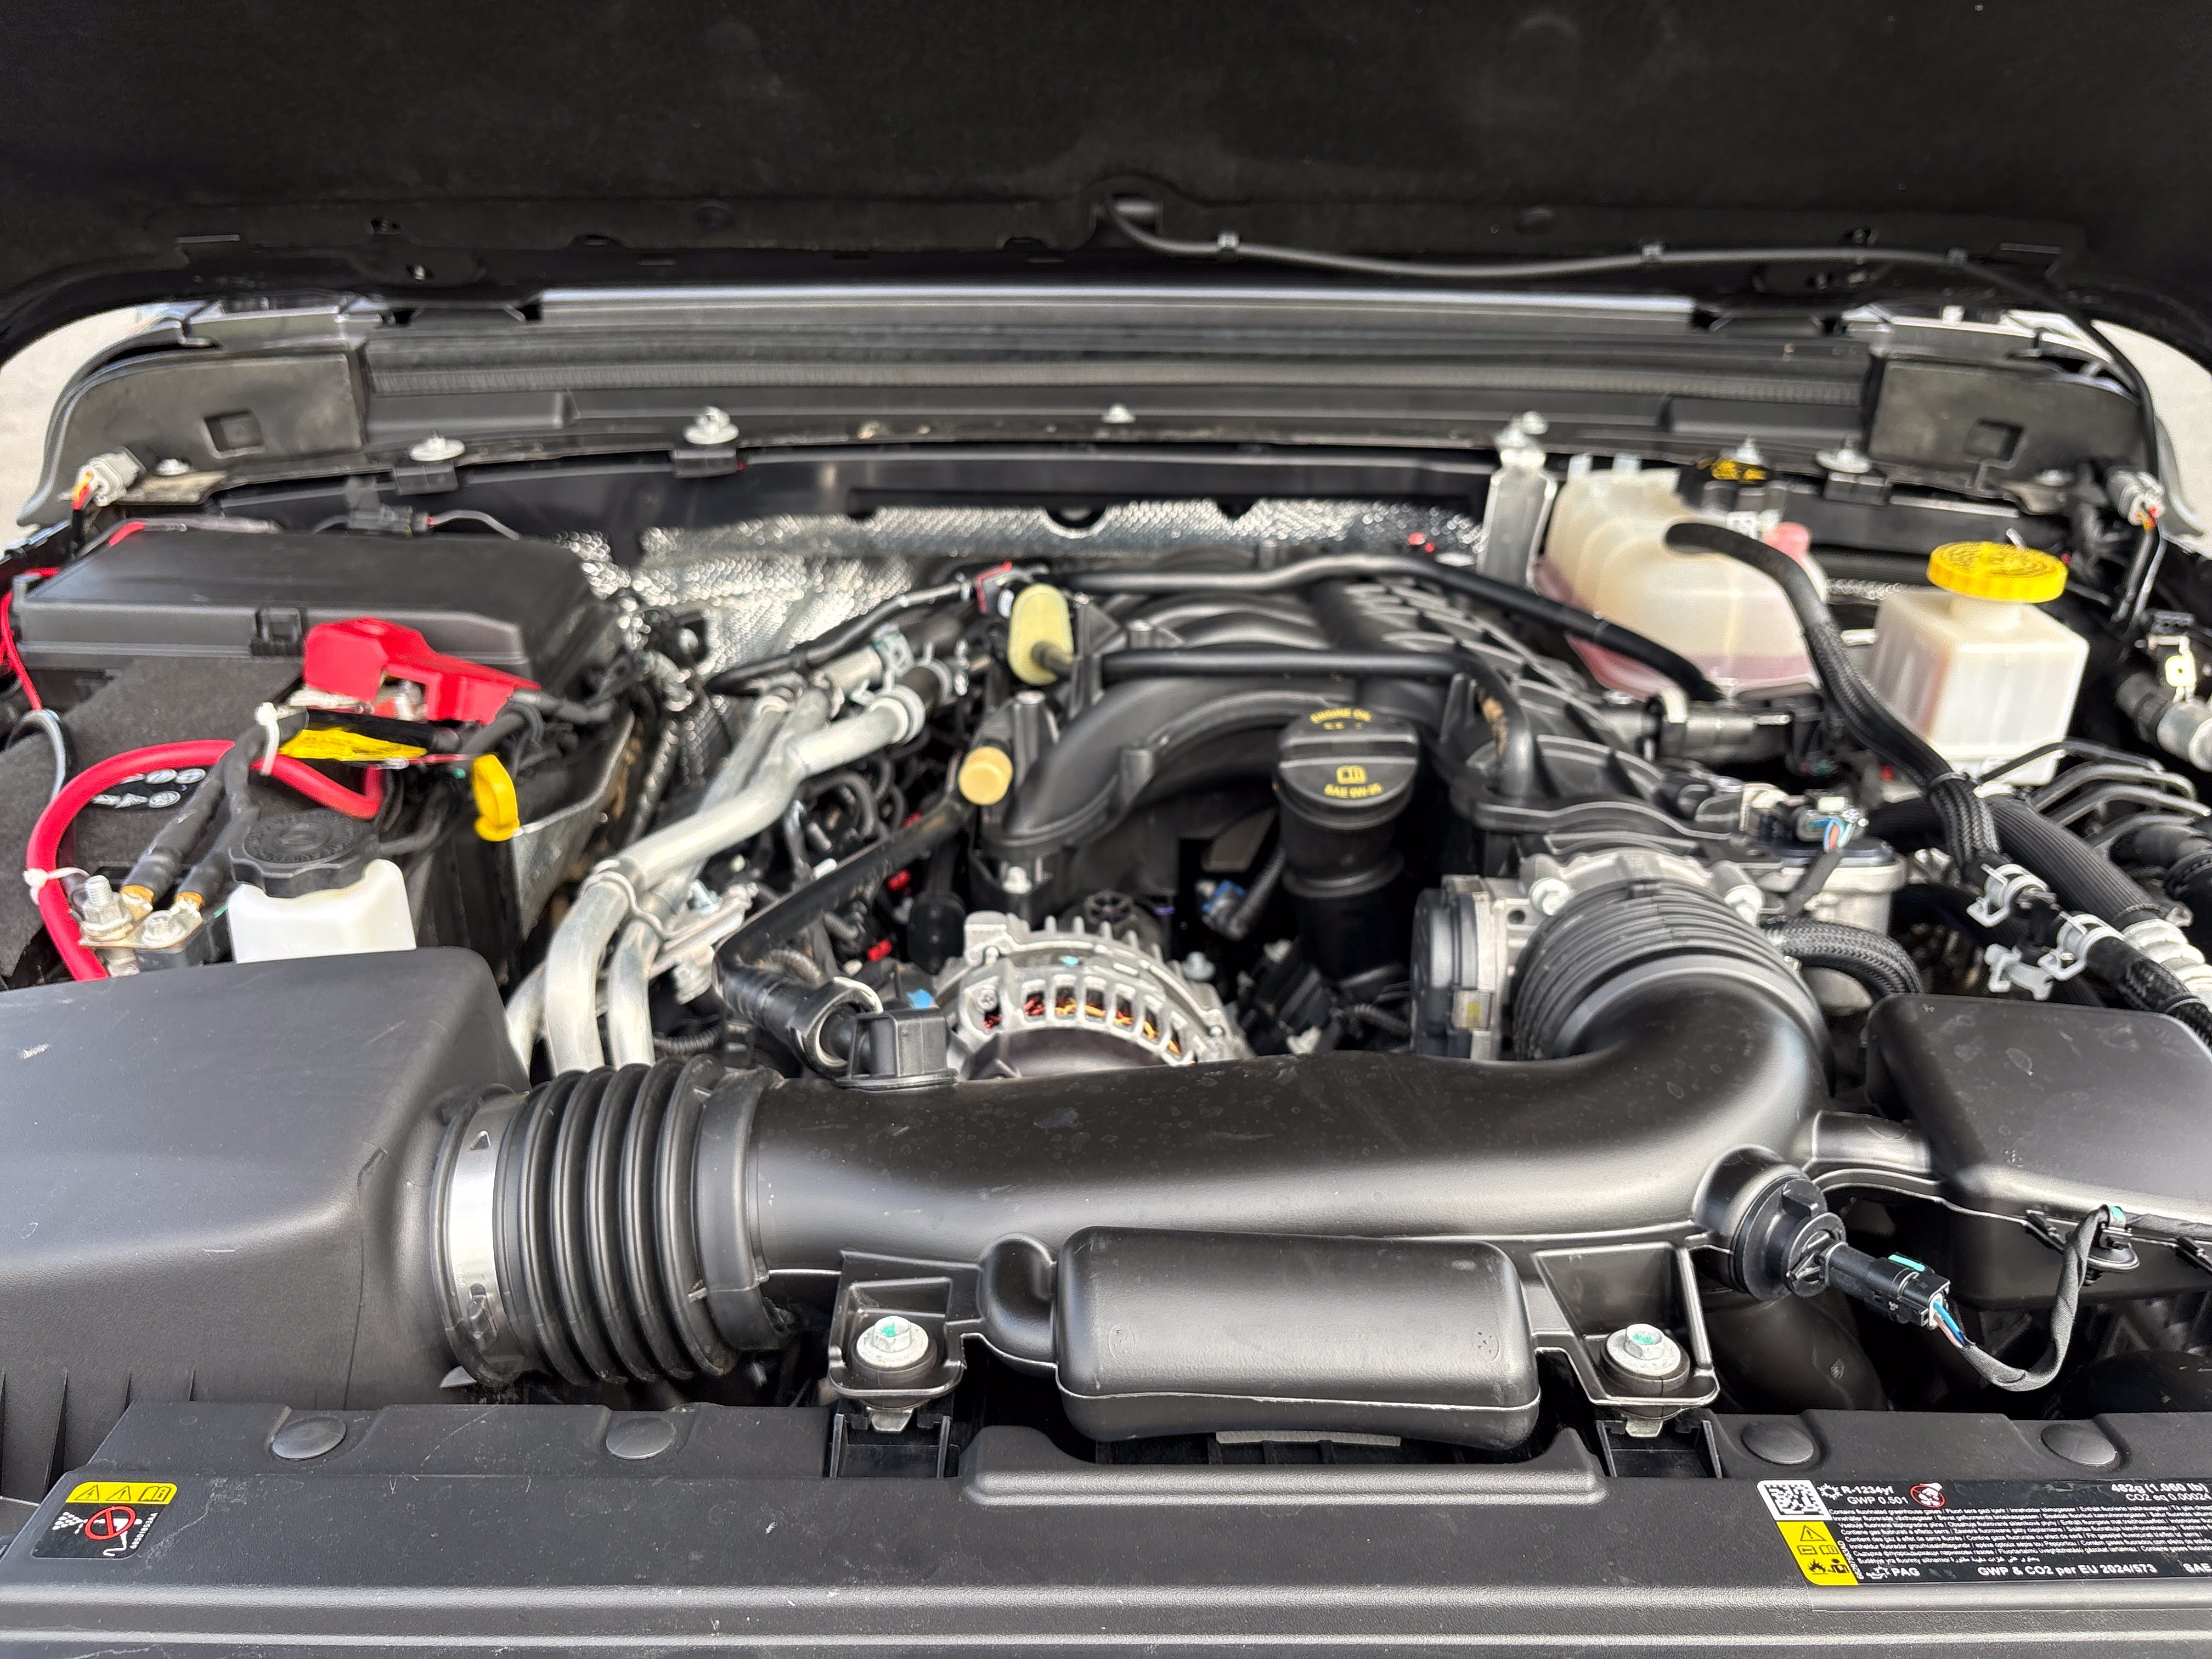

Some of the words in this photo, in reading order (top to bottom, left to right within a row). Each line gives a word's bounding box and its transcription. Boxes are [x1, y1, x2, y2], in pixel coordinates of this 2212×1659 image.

[1310, 707, 1351, 724] ENGINE
[1324, 783, 1348, 799] SAE
[1840, 1485, 1895, 1496] R-1234yf
[2111, 1483, 2146, 1494] 482g
[2186, 1482, 2209, 1493] lb)
[1847, 1496, 1876, 1505] GWP
[1877, 1495, 1909, 1505] 0.501
[2125, 1493, 2152, 1502] CO2
[2152, 1494, 2170, 1502] eq
[1891, 1567, 1920, 1577] PAG
[1977, 1566, 2009, 1576] GWP
[2012, 1566, 2024, 1575] &
[2024, 1565, 2055, 1575] CO2
[2055, 1566, 2077, 1576] per
[2078, 1564, 2098, 1574] EU
[2099, 1563, 2158, 1574] 2024/573
[2182, 1562, 2212, 1573] SAE
